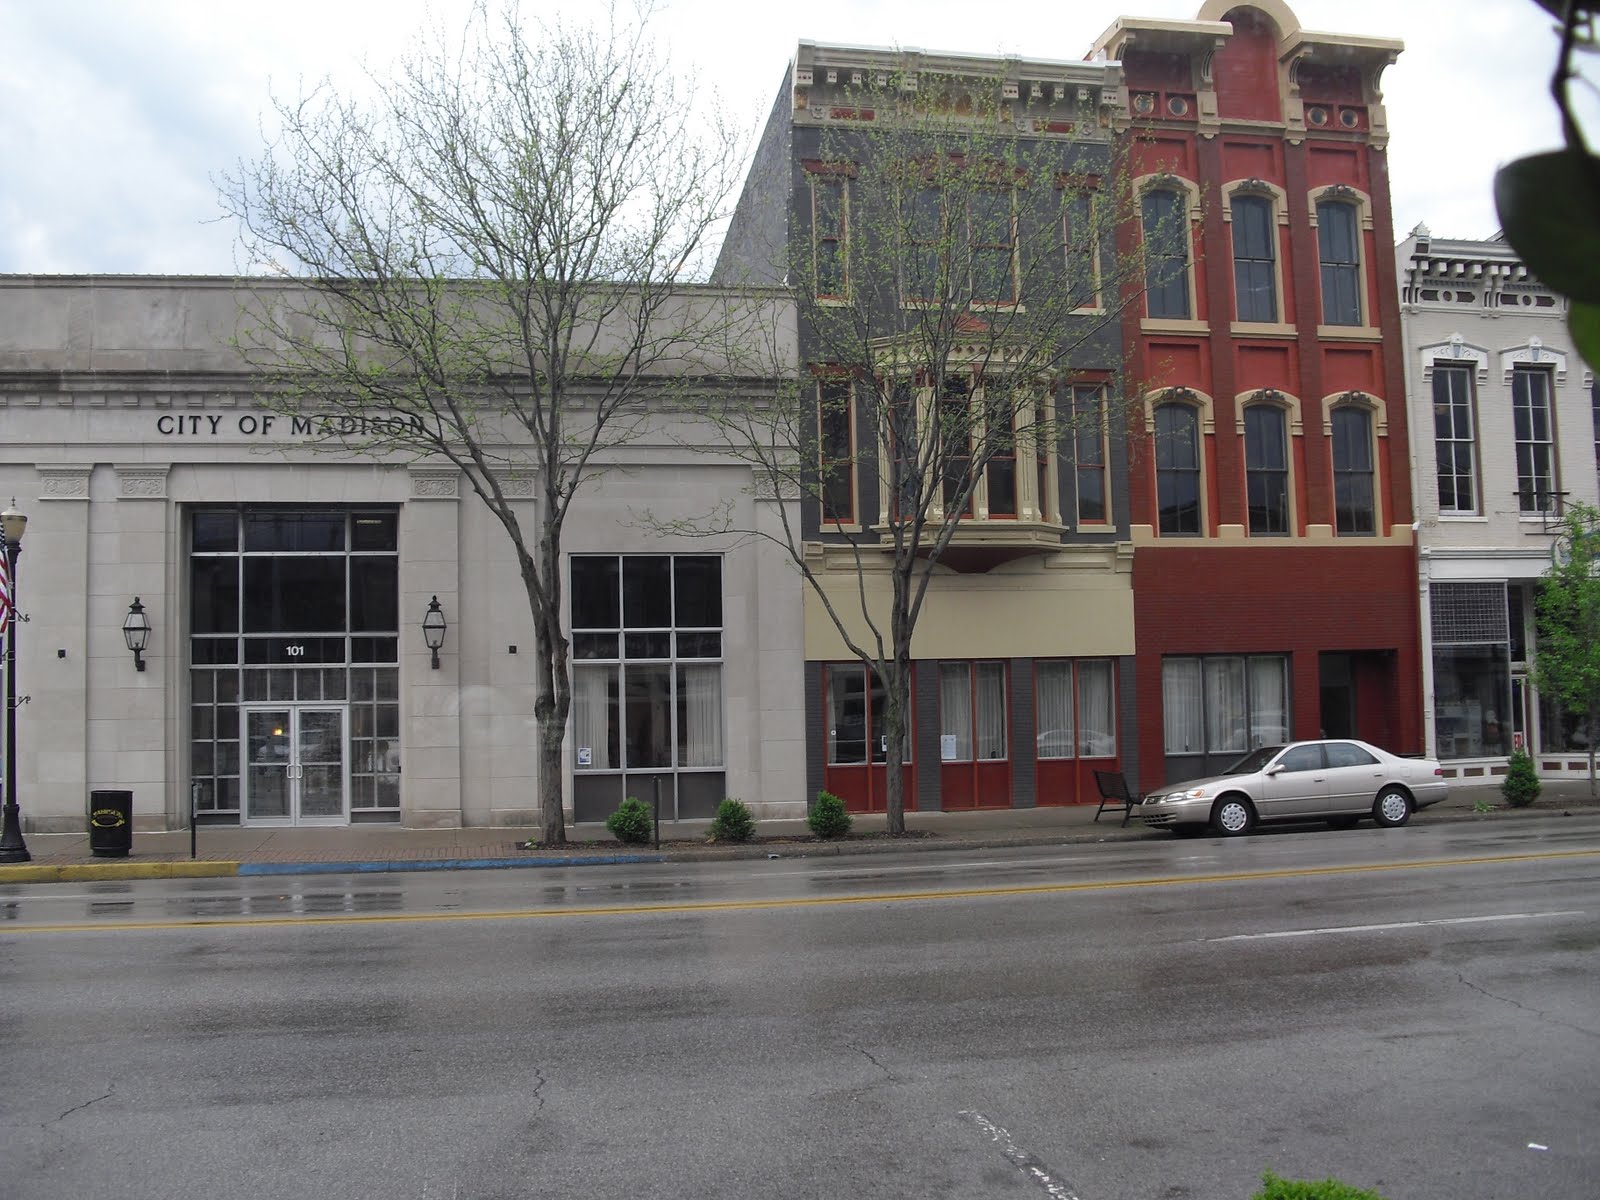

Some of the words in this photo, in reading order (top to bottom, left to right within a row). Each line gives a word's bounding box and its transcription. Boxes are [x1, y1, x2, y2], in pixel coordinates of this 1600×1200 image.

[156, 415, 222, 435] CITY
[238, 415, 276, 435] OF
[290, 415, 425, 436] MADISON
[286, 645, 304, 656] 101
